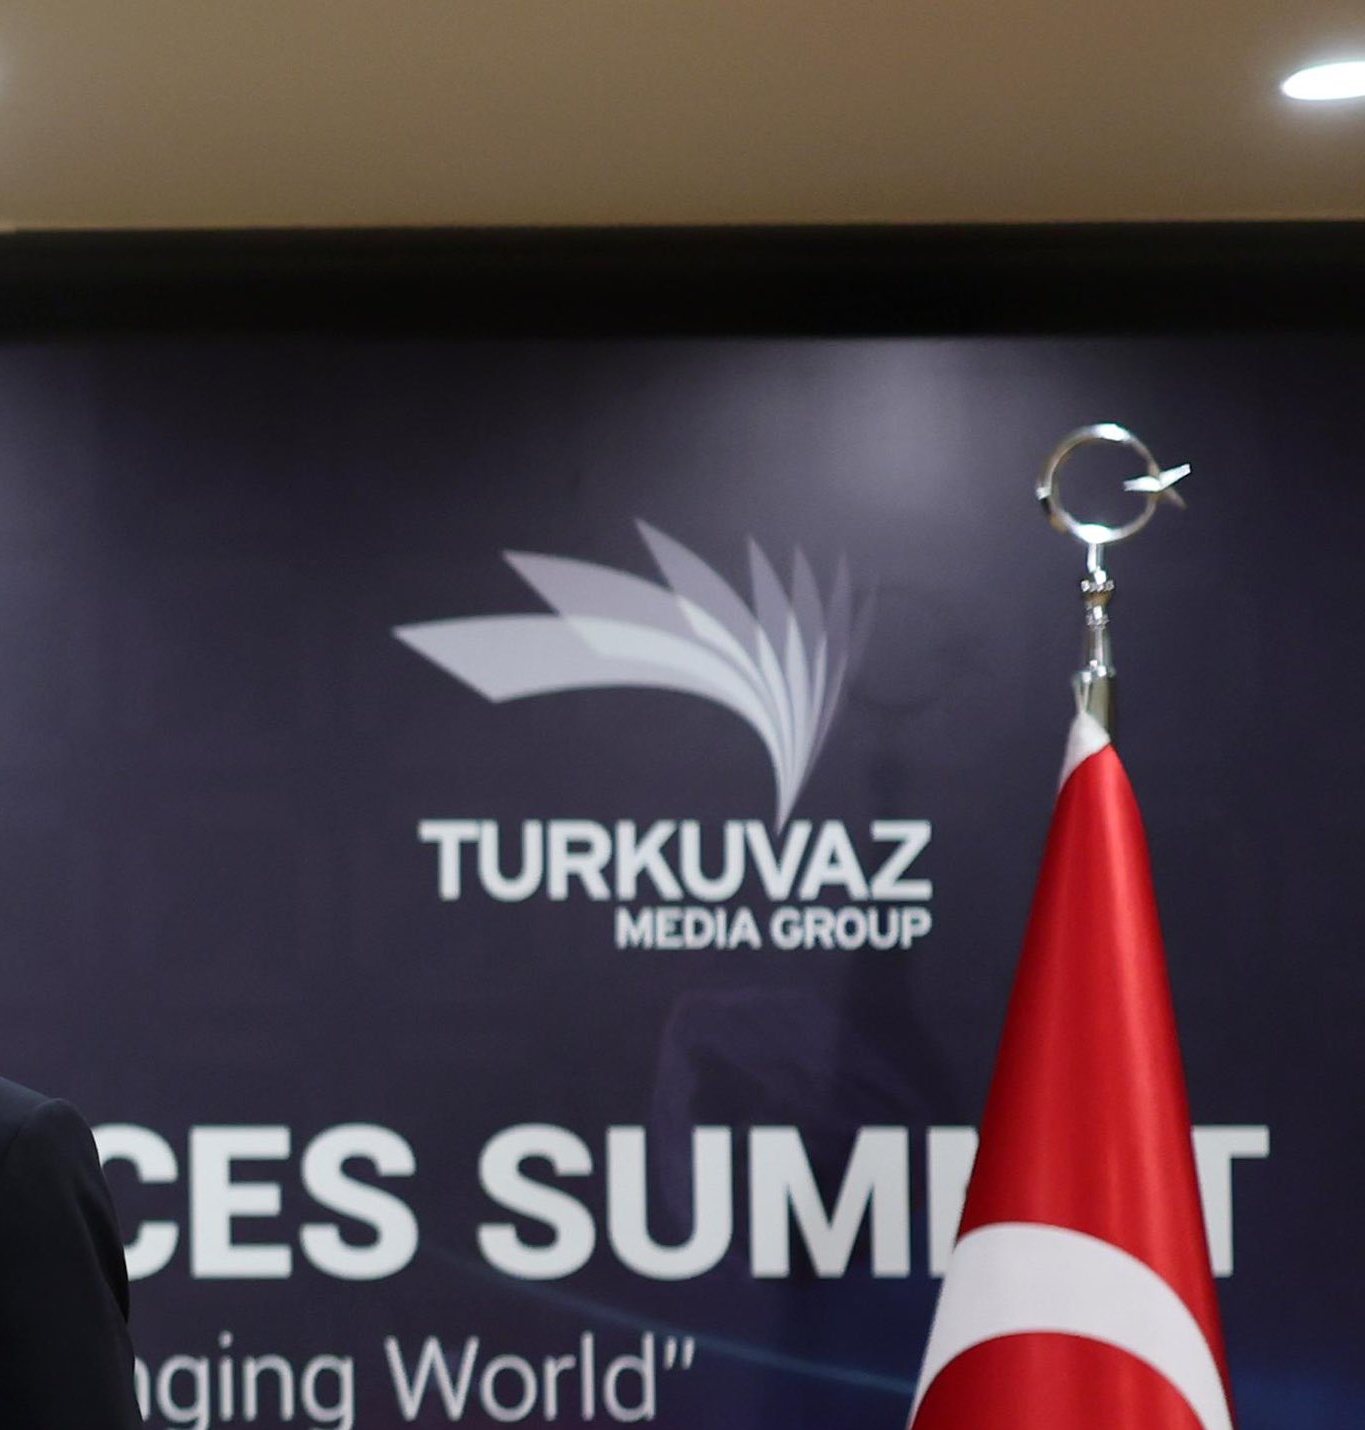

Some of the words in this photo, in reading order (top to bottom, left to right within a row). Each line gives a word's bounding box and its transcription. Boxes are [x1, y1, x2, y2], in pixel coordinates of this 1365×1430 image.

[418, 819, 933, 901] TURKUVAZ
[615, 906, 762, 949] MEDIA
[769, 906, 932, 950] GROUP
[477, 1123, 1270, 1280] SUMT
